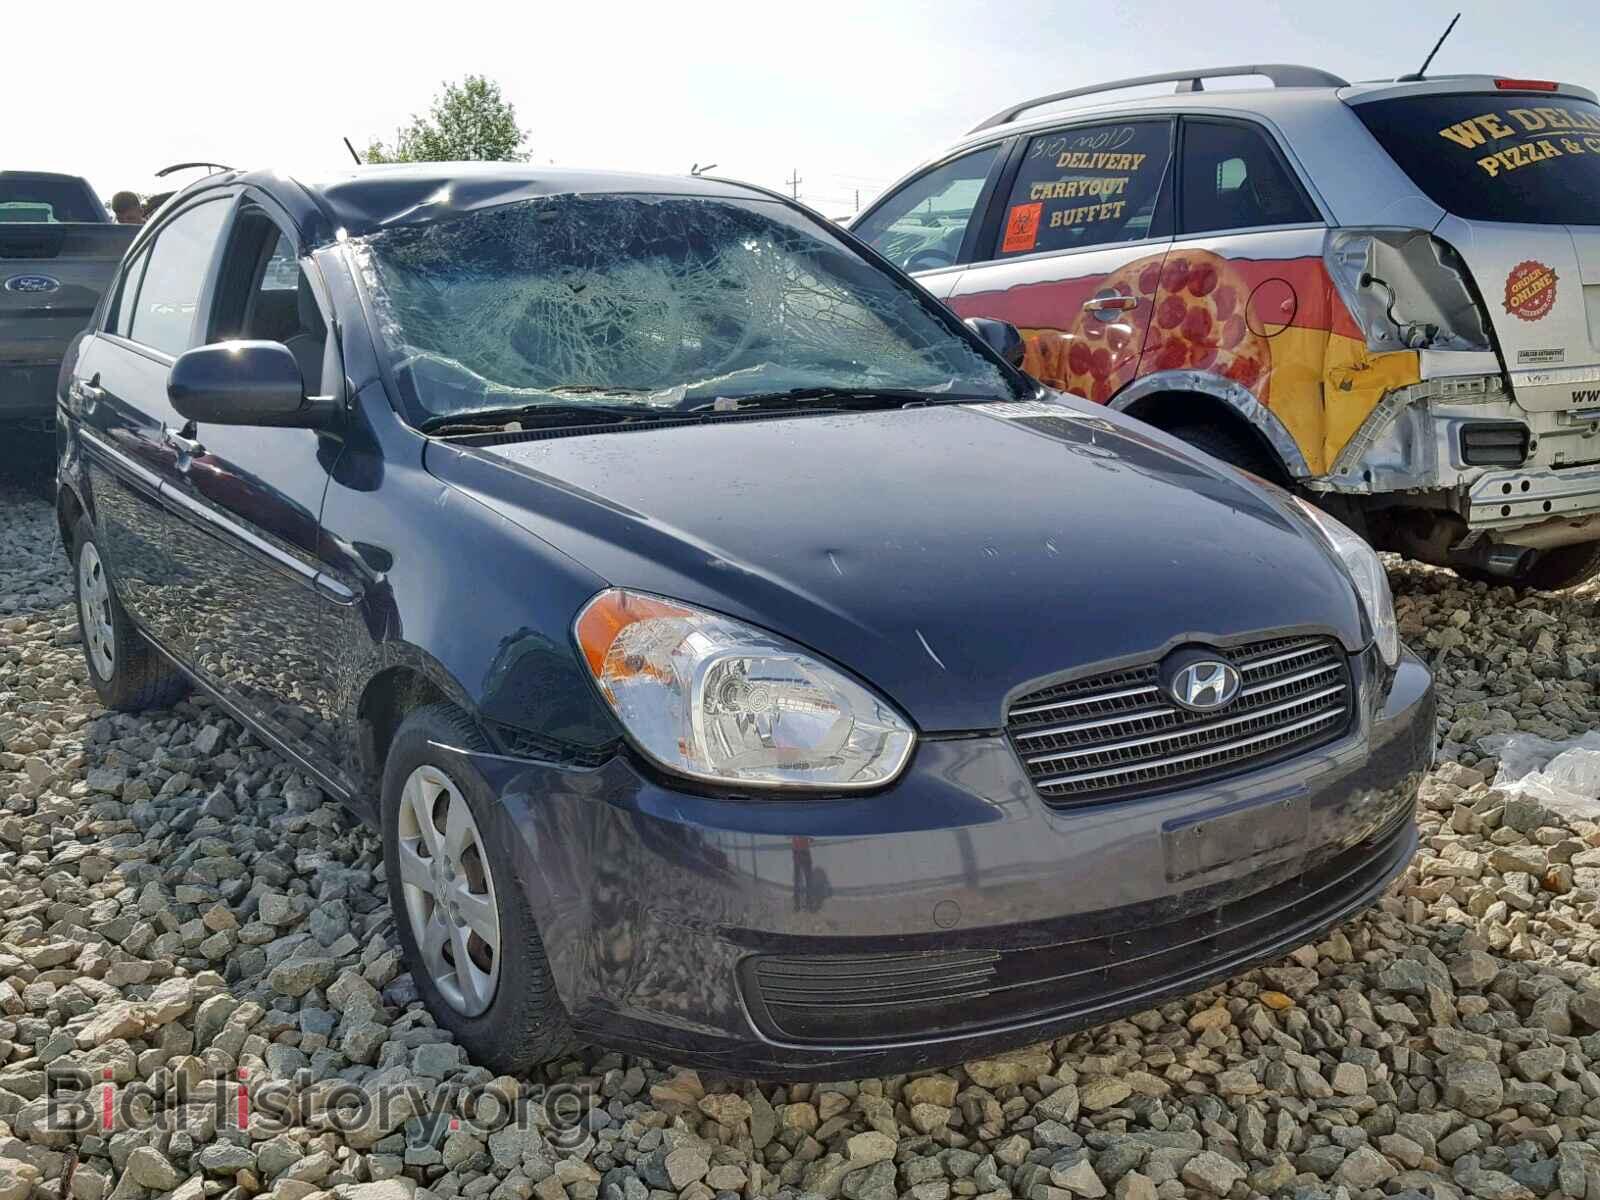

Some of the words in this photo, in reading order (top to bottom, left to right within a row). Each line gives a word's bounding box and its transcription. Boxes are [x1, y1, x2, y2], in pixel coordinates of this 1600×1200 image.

[1438, 113, 1516, 149] WE
[1056, 152, 1146, 171] DELIVERY
[1476, 140, 1563, 177] PIZZA
[1560, 138, 1586, 154] &
[1030, 177, 1130, 200] CARRYOUT
[1049, 201, 1127, 228] BUFFET
[1510, 273, 1553, 308] ONLINE
[1511, 268, 1544, 293] ORDER
